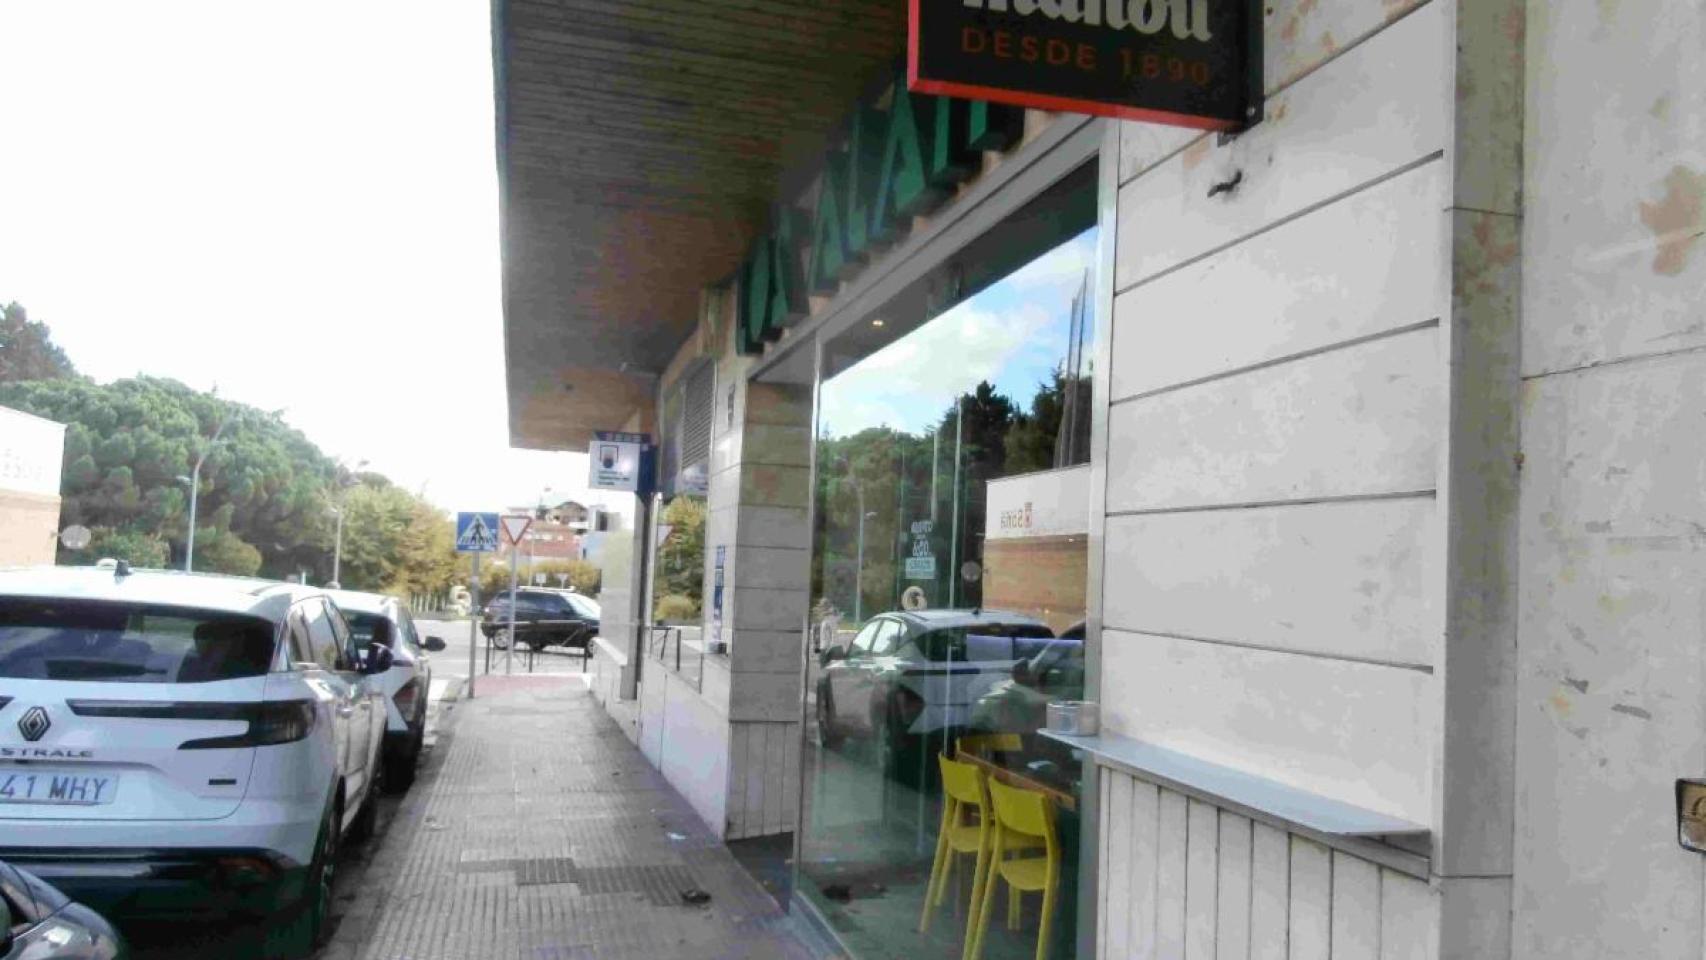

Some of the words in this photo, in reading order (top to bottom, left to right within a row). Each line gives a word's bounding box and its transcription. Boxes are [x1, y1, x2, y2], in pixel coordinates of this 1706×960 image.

[961, 27, 1096, 69] DESDE
[1120, 50, 1208, 85] 1890
[0, 774, 37, 798] 41
[48, 775, 109, 800] MHY
